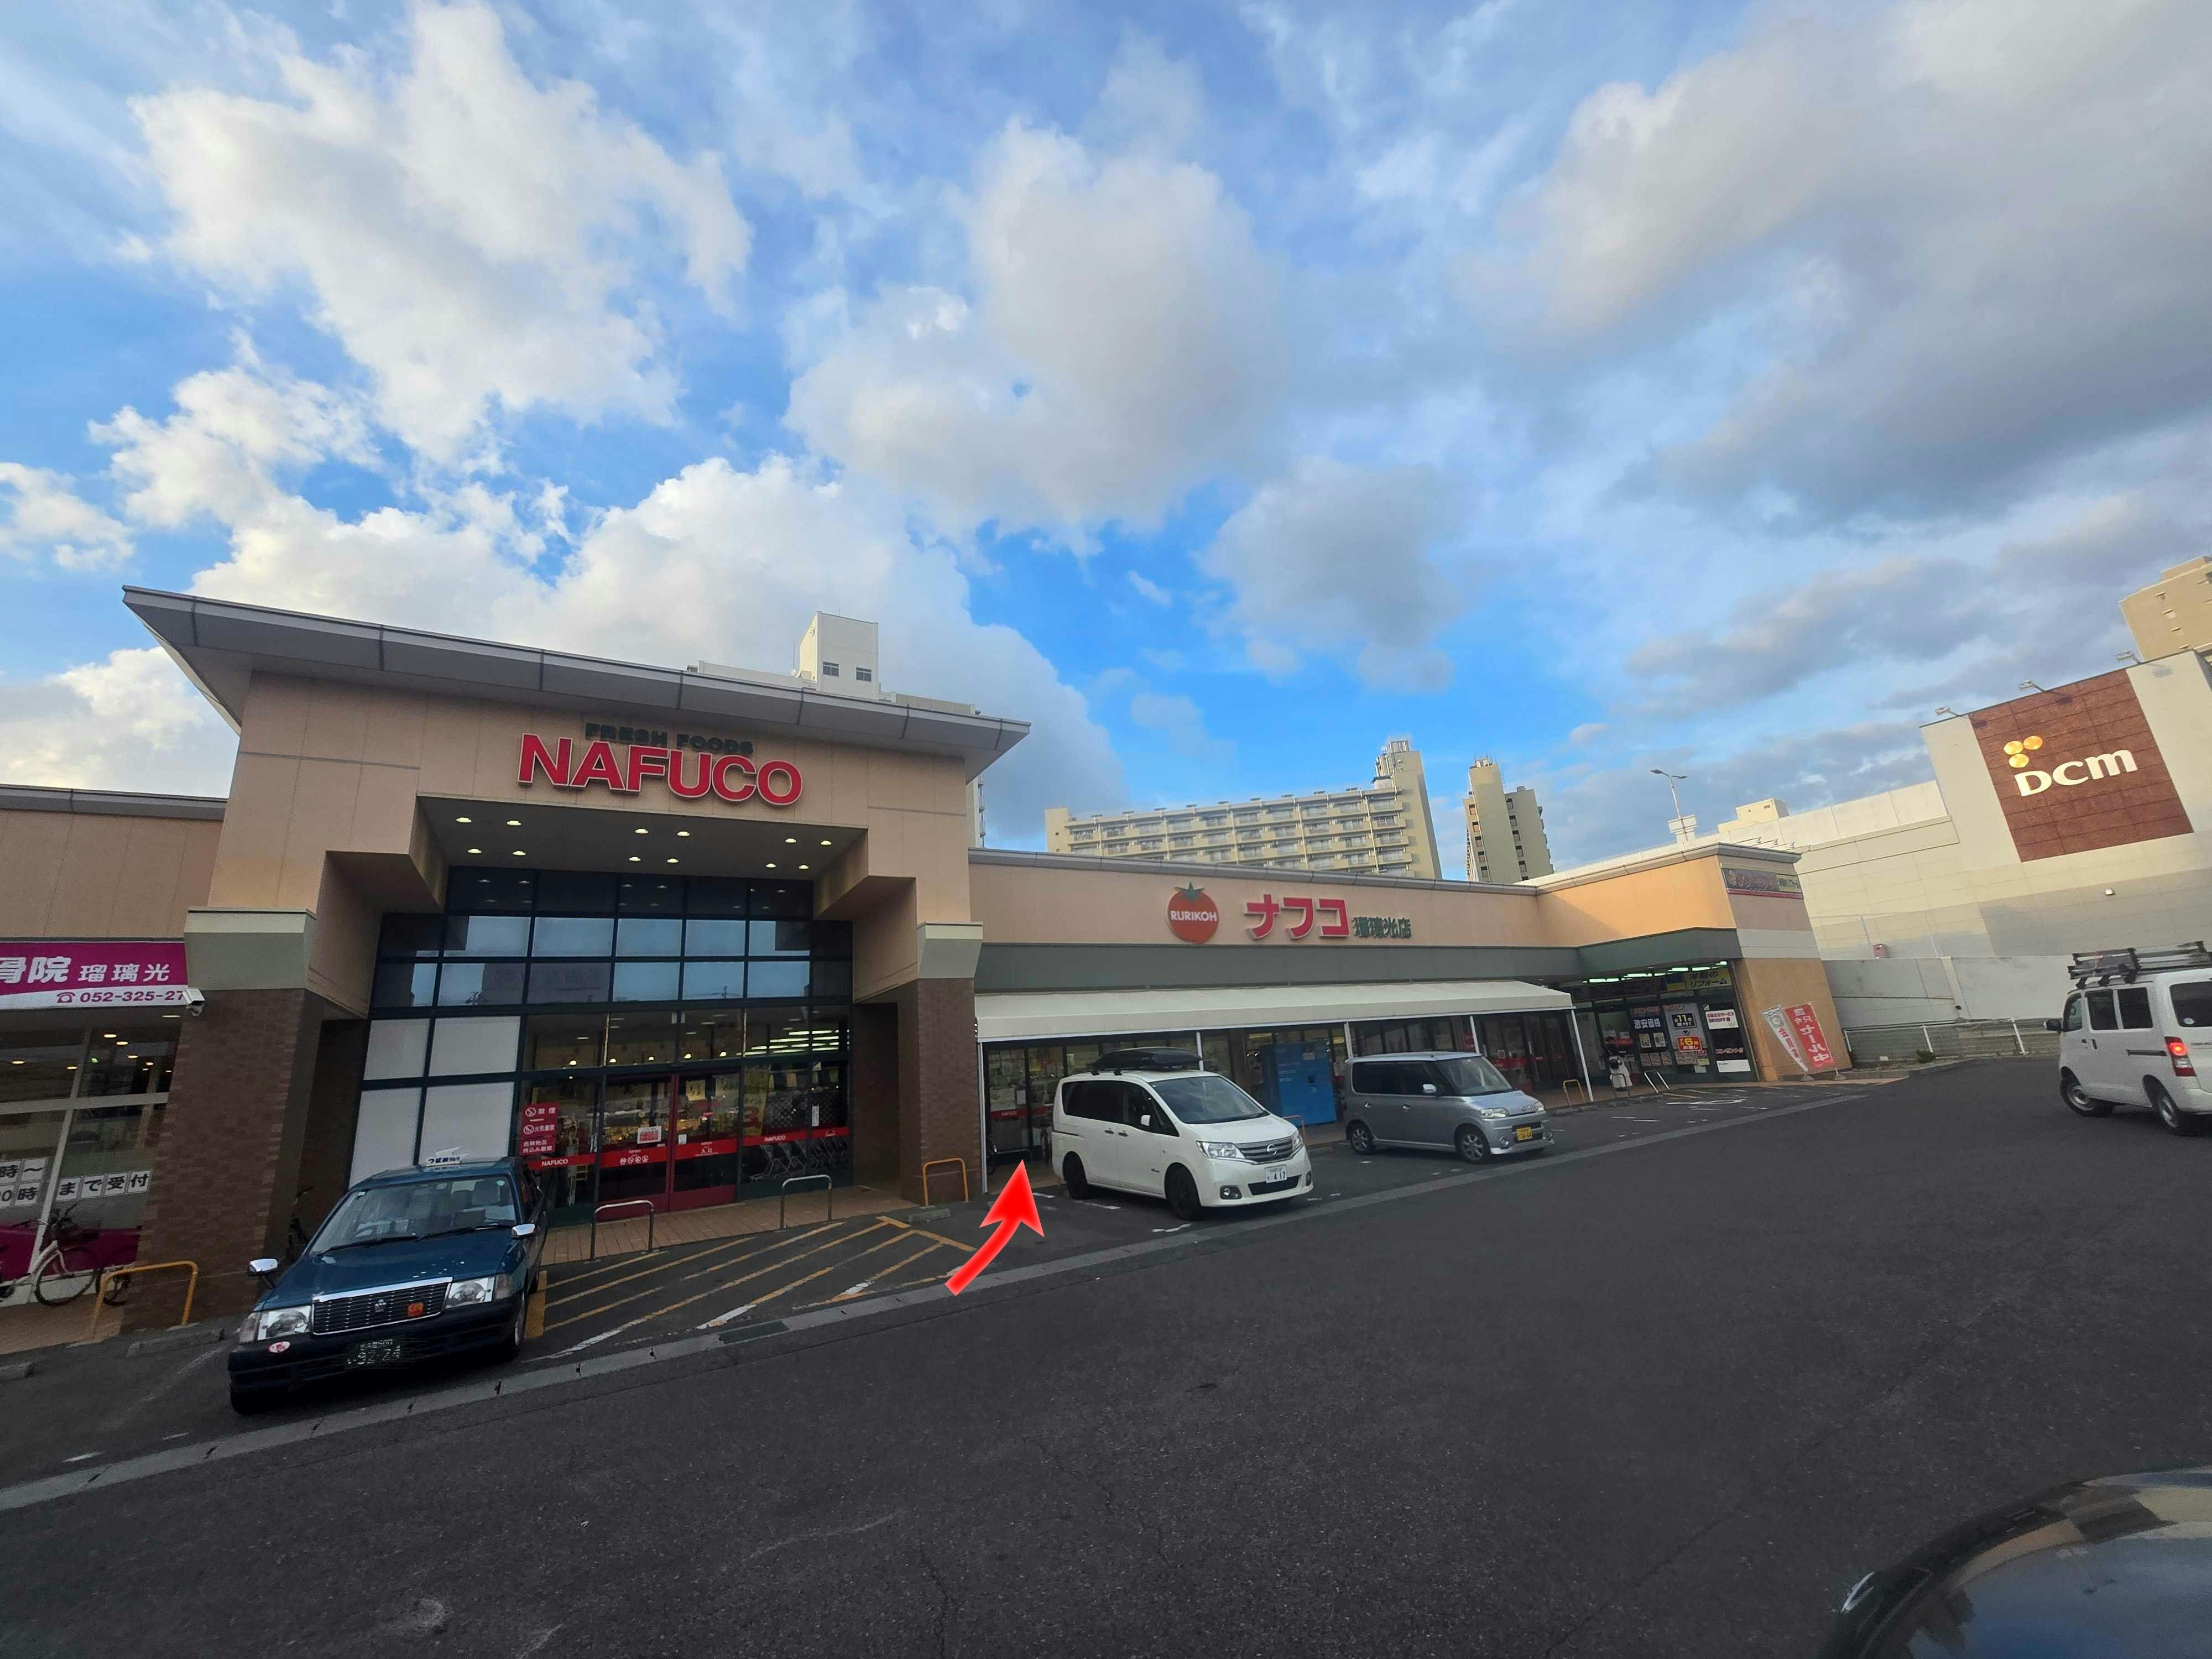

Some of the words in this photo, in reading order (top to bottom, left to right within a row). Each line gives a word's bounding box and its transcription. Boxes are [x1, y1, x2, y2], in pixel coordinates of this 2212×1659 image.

[585, 723, 668, 747] FRESH
[676, 733, 753, 755] FOODS
[518, 733, 804, 806] NAFUCO
[1171, 910, 1217, 922] RURIKOH
[1244, 894, 1350, 940] ナフコ
[77, 963, 170, 982] 瑠璃光
[1691, 978, 1728, 988] リフォーム
[59, 1173, 149, 1196] まで受付
